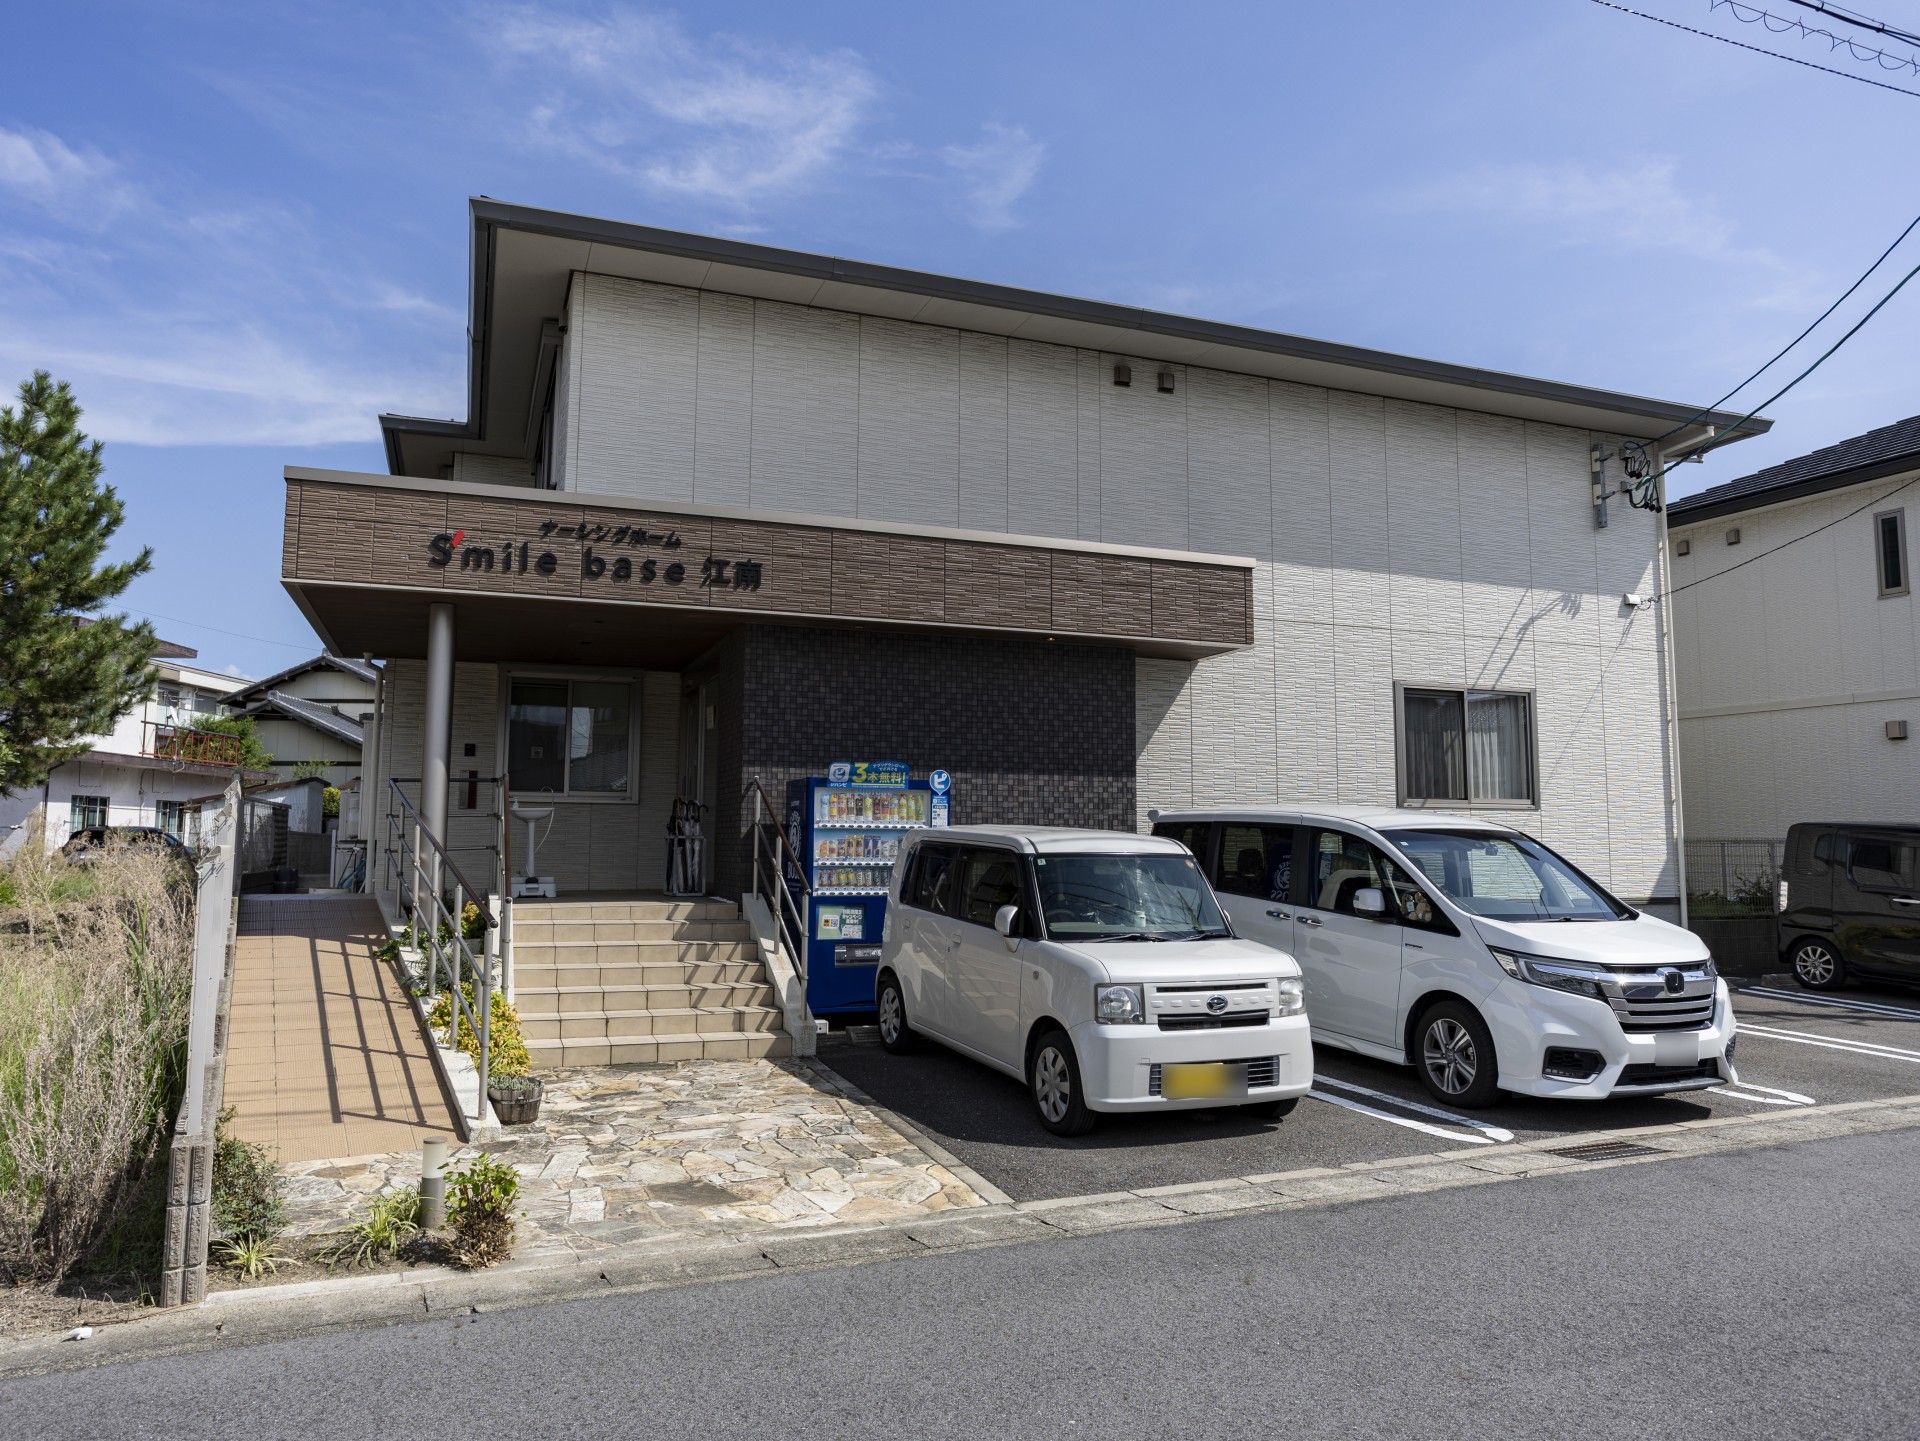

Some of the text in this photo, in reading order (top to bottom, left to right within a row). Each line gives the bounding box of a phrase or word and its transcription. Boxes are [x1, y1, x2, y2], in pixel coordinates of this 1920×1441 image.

[541, 520, 681, 548] ナーシングホーム
[583, 547, 686, 583] base
[701, 558, 763, 590] 江南
